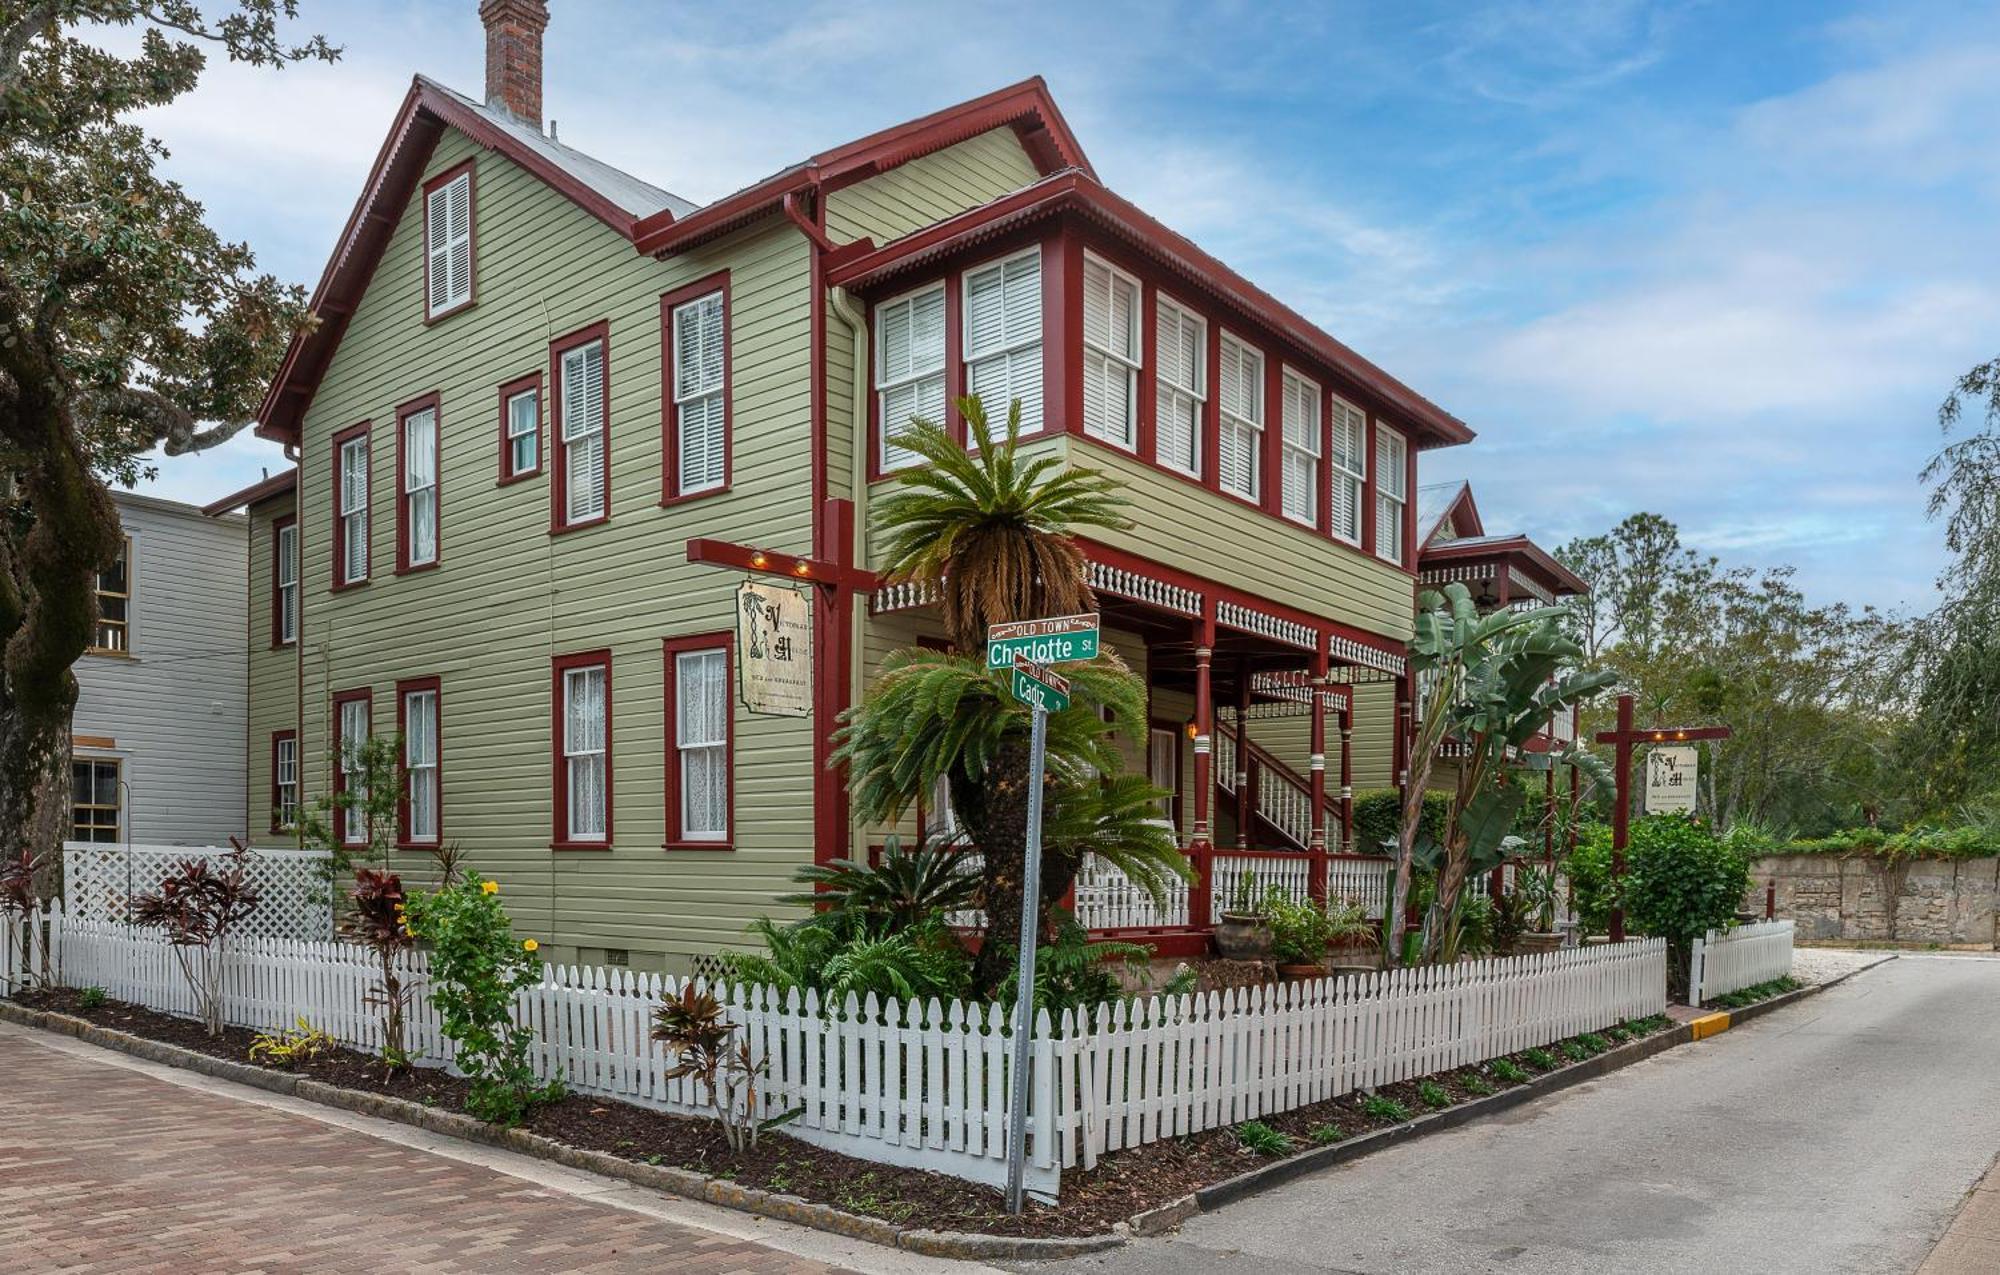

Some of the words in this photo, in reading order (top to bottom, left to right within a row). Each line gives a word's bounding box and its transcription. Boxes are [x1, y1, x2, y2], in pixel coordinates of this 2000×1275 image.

[1016, 624, 1036, 636] OLD
[1042, 620, 1070, 633] TOWN
[1019, 677, 1045, 705] Cadiz
